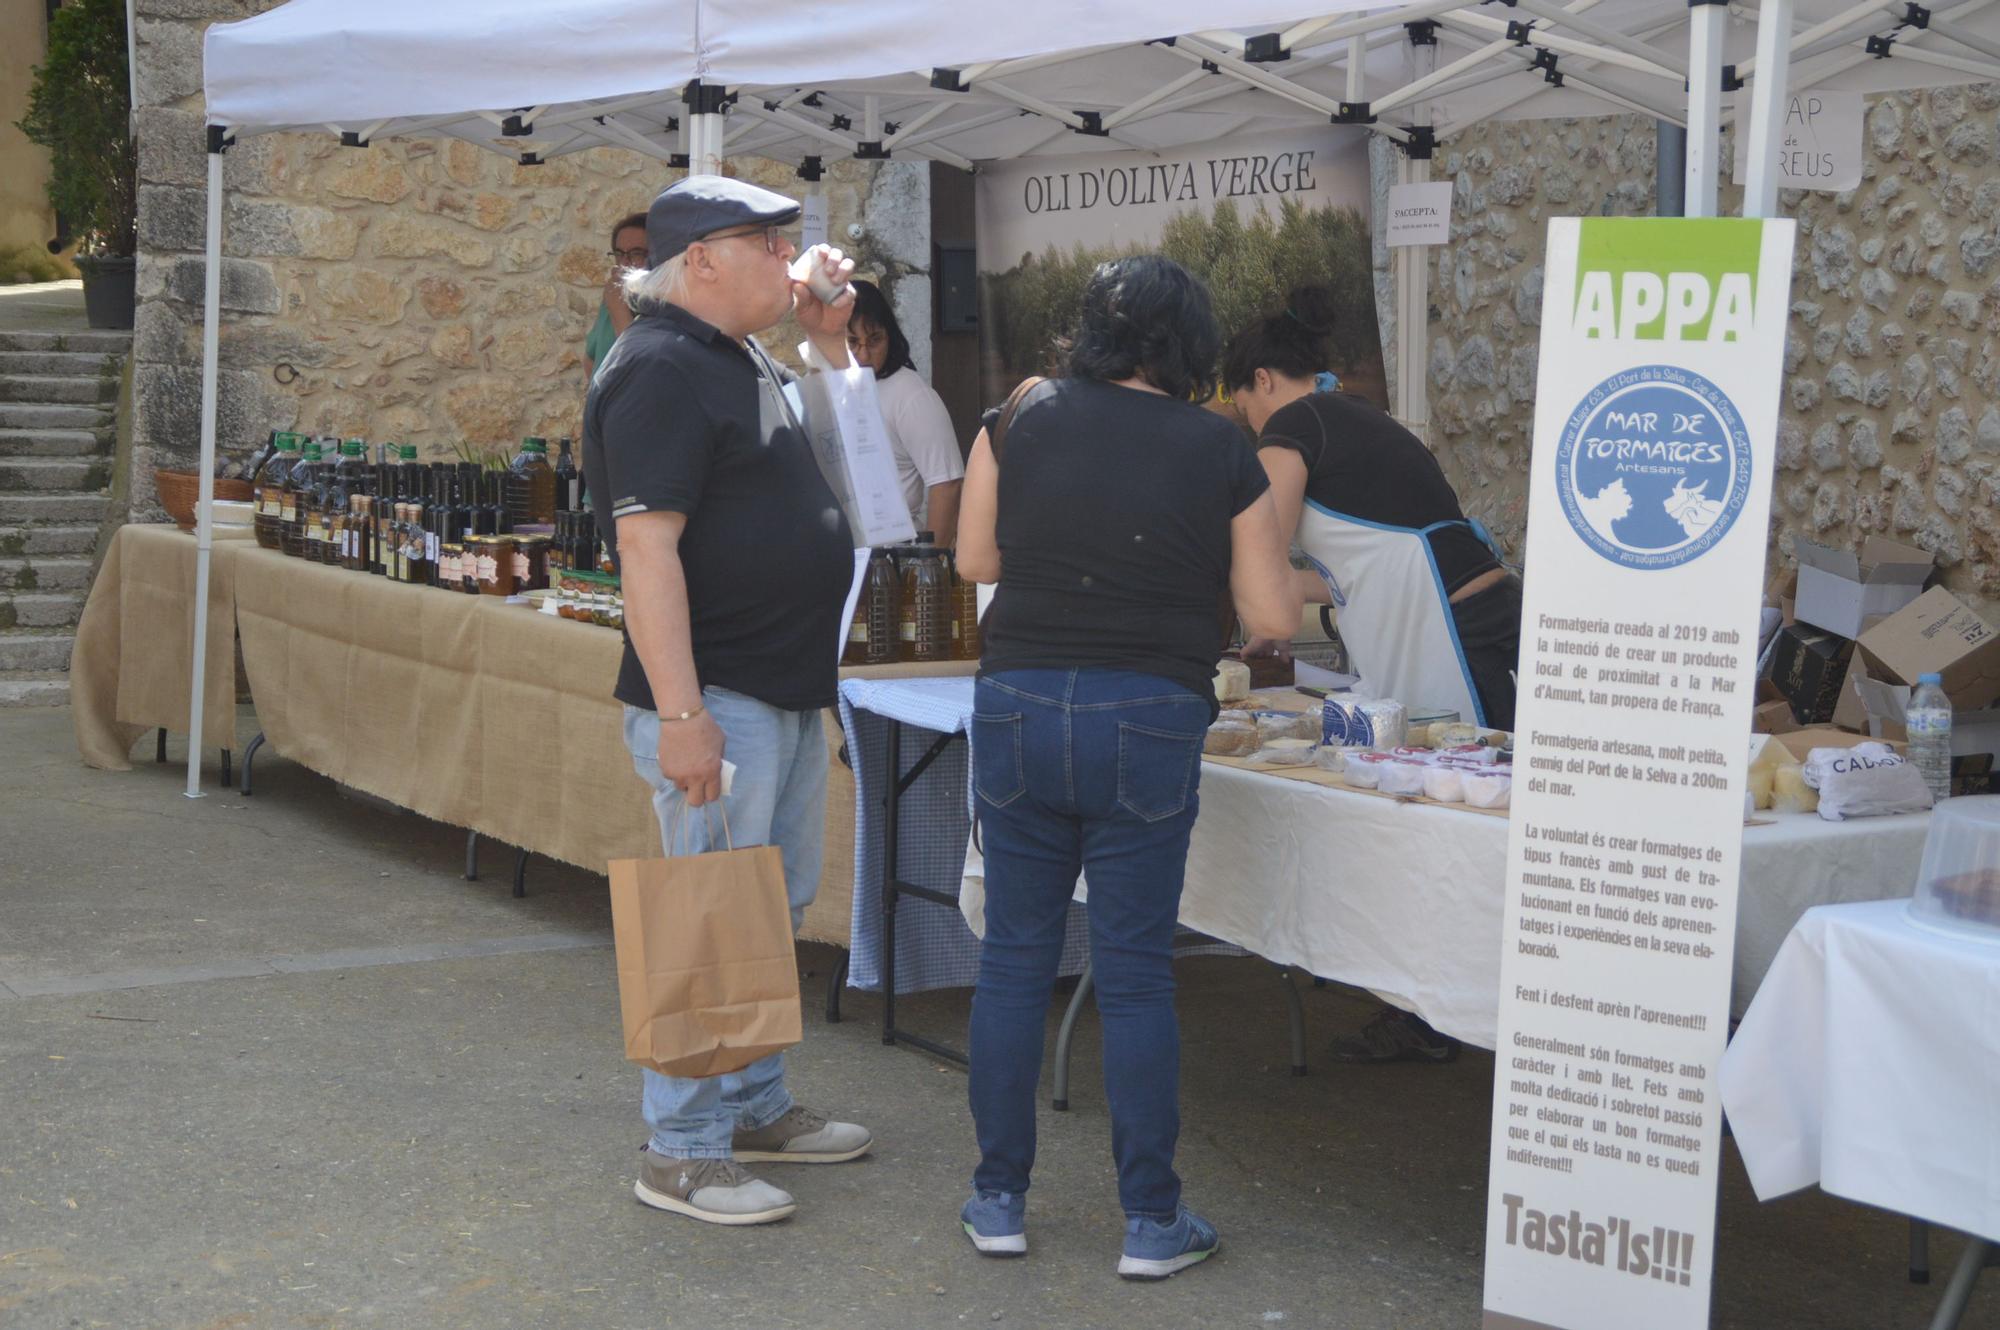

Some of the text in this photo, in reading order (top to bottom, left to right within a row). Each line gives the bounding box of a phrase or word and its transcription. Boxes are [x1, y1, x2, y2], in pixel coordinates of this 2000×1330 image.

[1785, 97, 1822, 125] AP
[1784, 134, 1798, 146] de
[1024, 150, 1316, 214] OLI D'OLIVA VERGE
[1572, 271, 1755, 341] APPA
[1607, 378, 1619, 393] El
[1653, 367, 1662, 380] la
[1588, 387, 1606, 407] 63
[1605, 411, 1706, 435] MAR DE
[1585, 437, 1723, 464] FORMATGES
[1733, 431, 1750, 456] 647
[1615, 462, 1686, 475] Artesans
[1736, 457, 1750, 483] 849
[1729, 485, 1747, 510] 750
[1538, 613, 1739, 644] Formatgeria creada al 2019 amb
[1537, 637, 1737, 669] la intenció de crear un producte
[1535, 660, 1736, 693] local de proximitat a la Mar
[1534, 684, 1724, 718] d'Amunt, tan propera de França.
[1531, 730, 1727, 767] Formatgeria artesana, molt petita,
[1528, 777, 1575, 796] del mar.
[1529, 755, 1727, 790] enmig del Port de la Selva a 200m
[1525, 823, 1722, 863] La voluntat és crear formatges de
[1523, 846, 1720, 886] tipus francès amb gust de tra-
[1522, 872, 1718, 910] muntana. Els formatges van evo-
[1520, 892, 1716, 934] lucionant en funció dels aprenen-
[1518, 938, 1559, 959] boració.
[1519, 916, 1554, 935] tatges
[1557, 921, 1561, 936] i
[1633, 935, 1648, 949] en
[1650, 935, 1661, 951] la
[1663, 940, 1690, 955] seva
[1692, 942, 1714, 958] ela-
[1515, 984, 1706, 1031] Fent i desfent aprèn l'aprenent!!!
[1513, 1031, 1706, 1079] Generalment són formatges amb
[1511, 1056, 1704, 1103] caràcter i amb llet. Fets amb
[1510, 1079, 1702, 1127] molta dedicació i sobretot passió
[1509, 1102, 1701, 1152] per elaborar un bon formatge
[1506, 1145, 1572, 1173] indiferent!!!
[1508, 1125, 1699, 1176] que el qui els tasta no es quedi
[1502, 1192, 1694, 1287] Tasta'ls!!!
